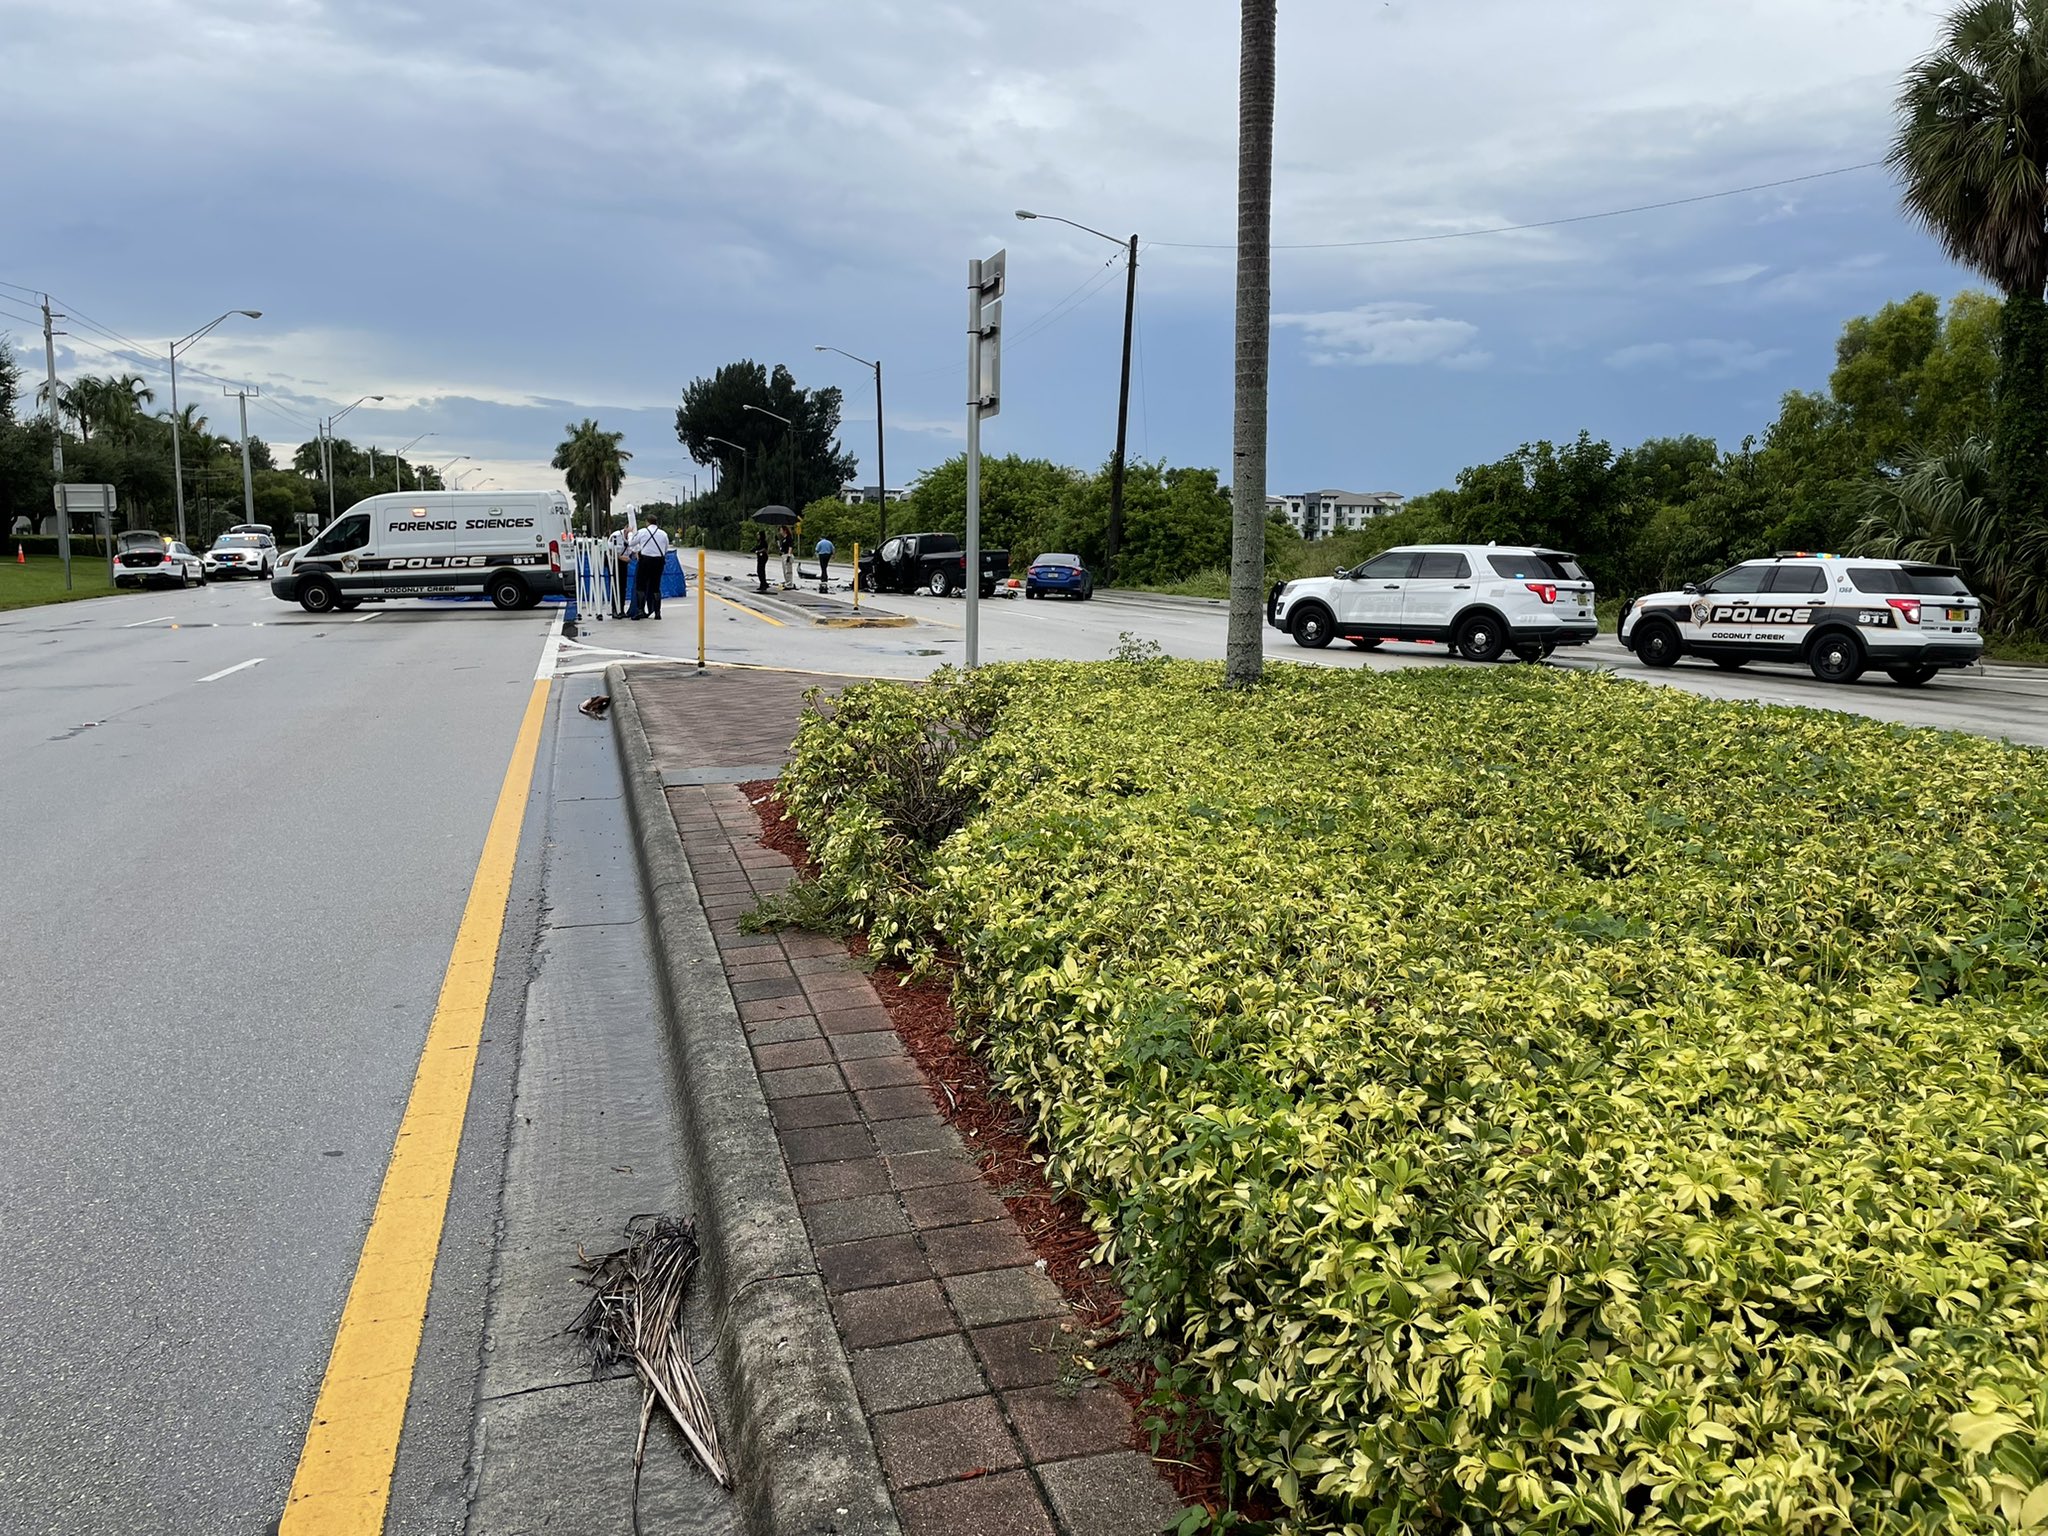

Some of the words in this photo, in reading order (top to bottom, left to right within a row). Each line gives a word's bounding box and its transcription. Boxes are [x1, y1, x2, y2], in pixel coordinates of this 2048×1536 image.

[389, 520, 457, 532] FORENSIC
[465, 518, 534, 530] SCIENCES
[388, 556, 487, 569] POLICE
[513, 557, 535, 565] 911
[1714, 608, 1812, 623] POLICE
[1858, 615, 1889, 624] 911
[1712, 632, 1752, 640] COCONUT
[1755, 633, 1785, 641] CREEK
